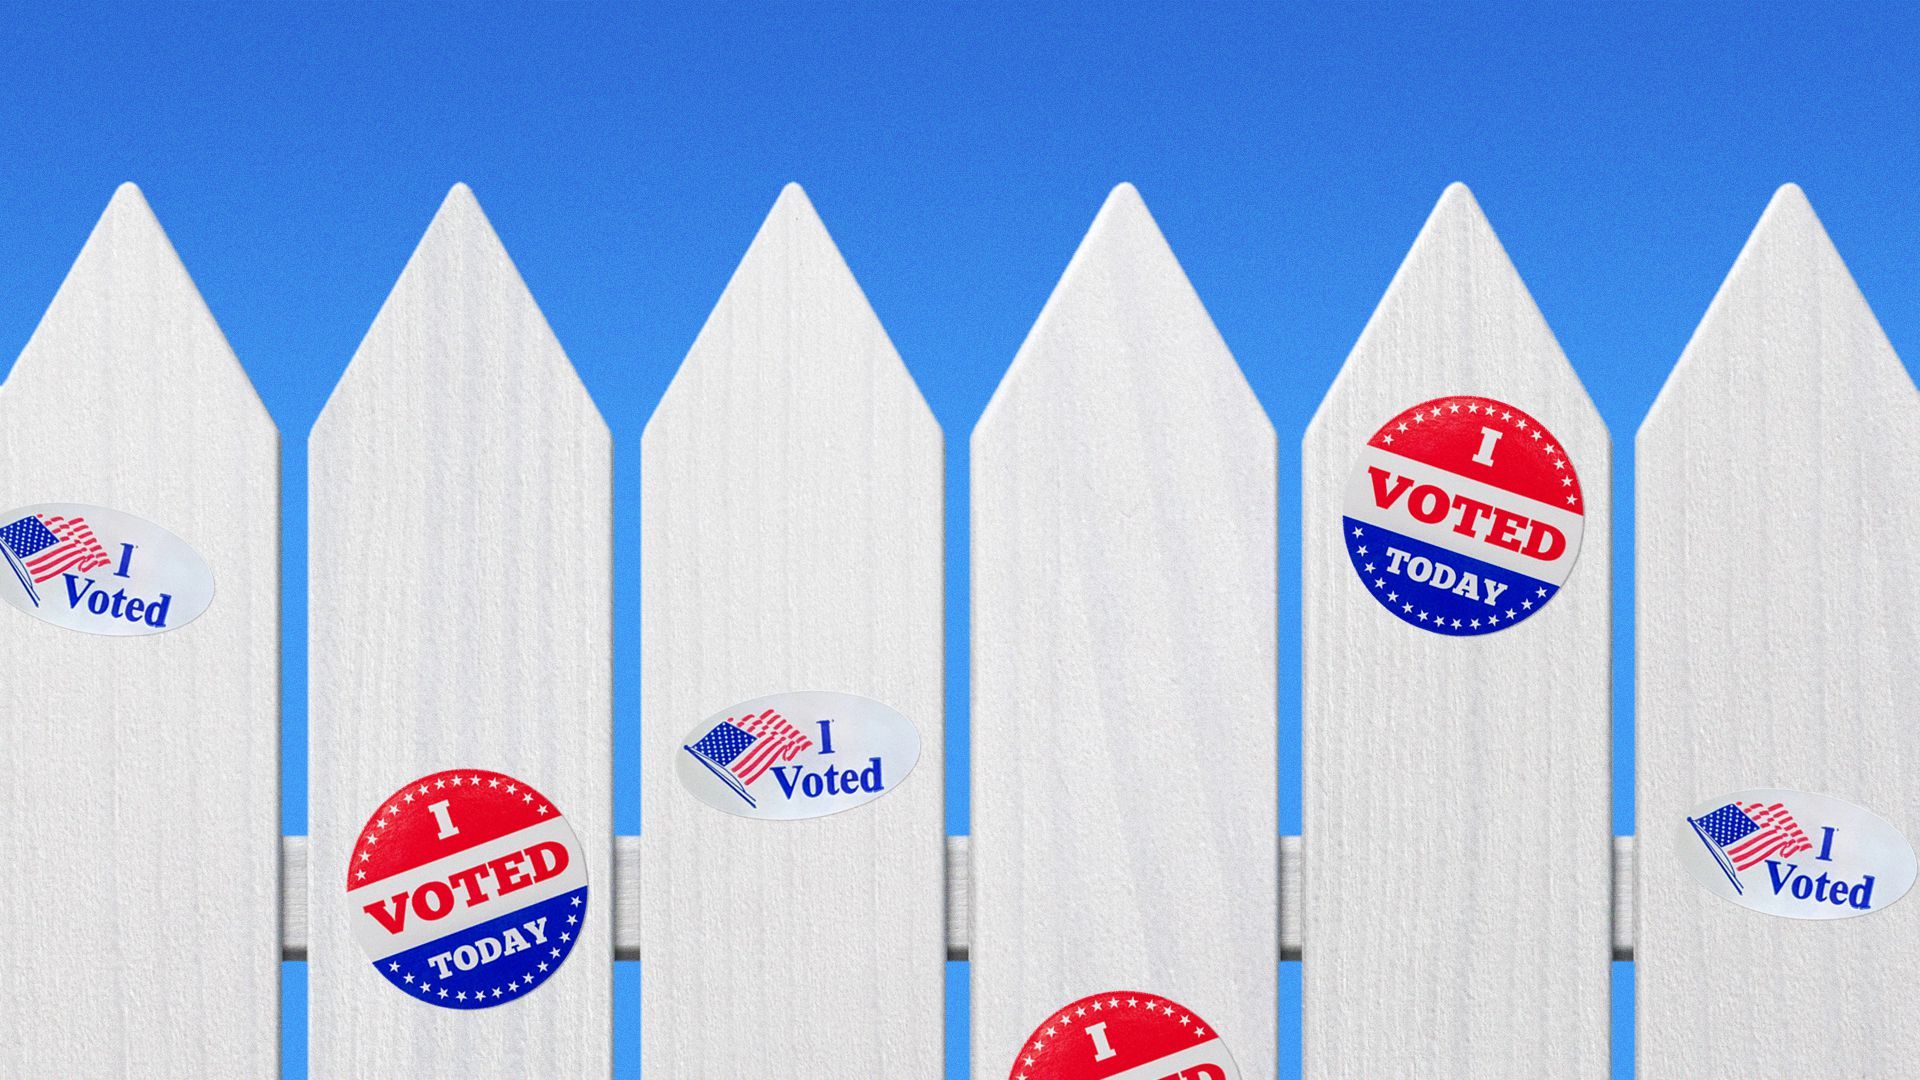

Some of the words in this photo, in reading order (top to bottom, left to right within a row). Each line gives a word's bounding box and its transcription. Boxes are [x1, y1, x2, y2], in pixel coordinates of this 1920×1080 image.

[1472, 426, 1503, 467] I
[1367, 465, 1567, 562] VOTED
[113, 542, 135, 578] I
[1385, 546, 1508, 607] TODAY
[62, 572, 172, 628] Voted
[816, 719, 836, 755] I
[769, 757, 885, 800] Voted
[428, 799, 460, 840] I
[1816, 826, 1835, 861] I
[363, 841, 570, 935] VOTED
[1764, 859, 1876, 911] Voted
[427, 916, 549, 980] TODAY
[1084, 1021, 1117, 1062] I
